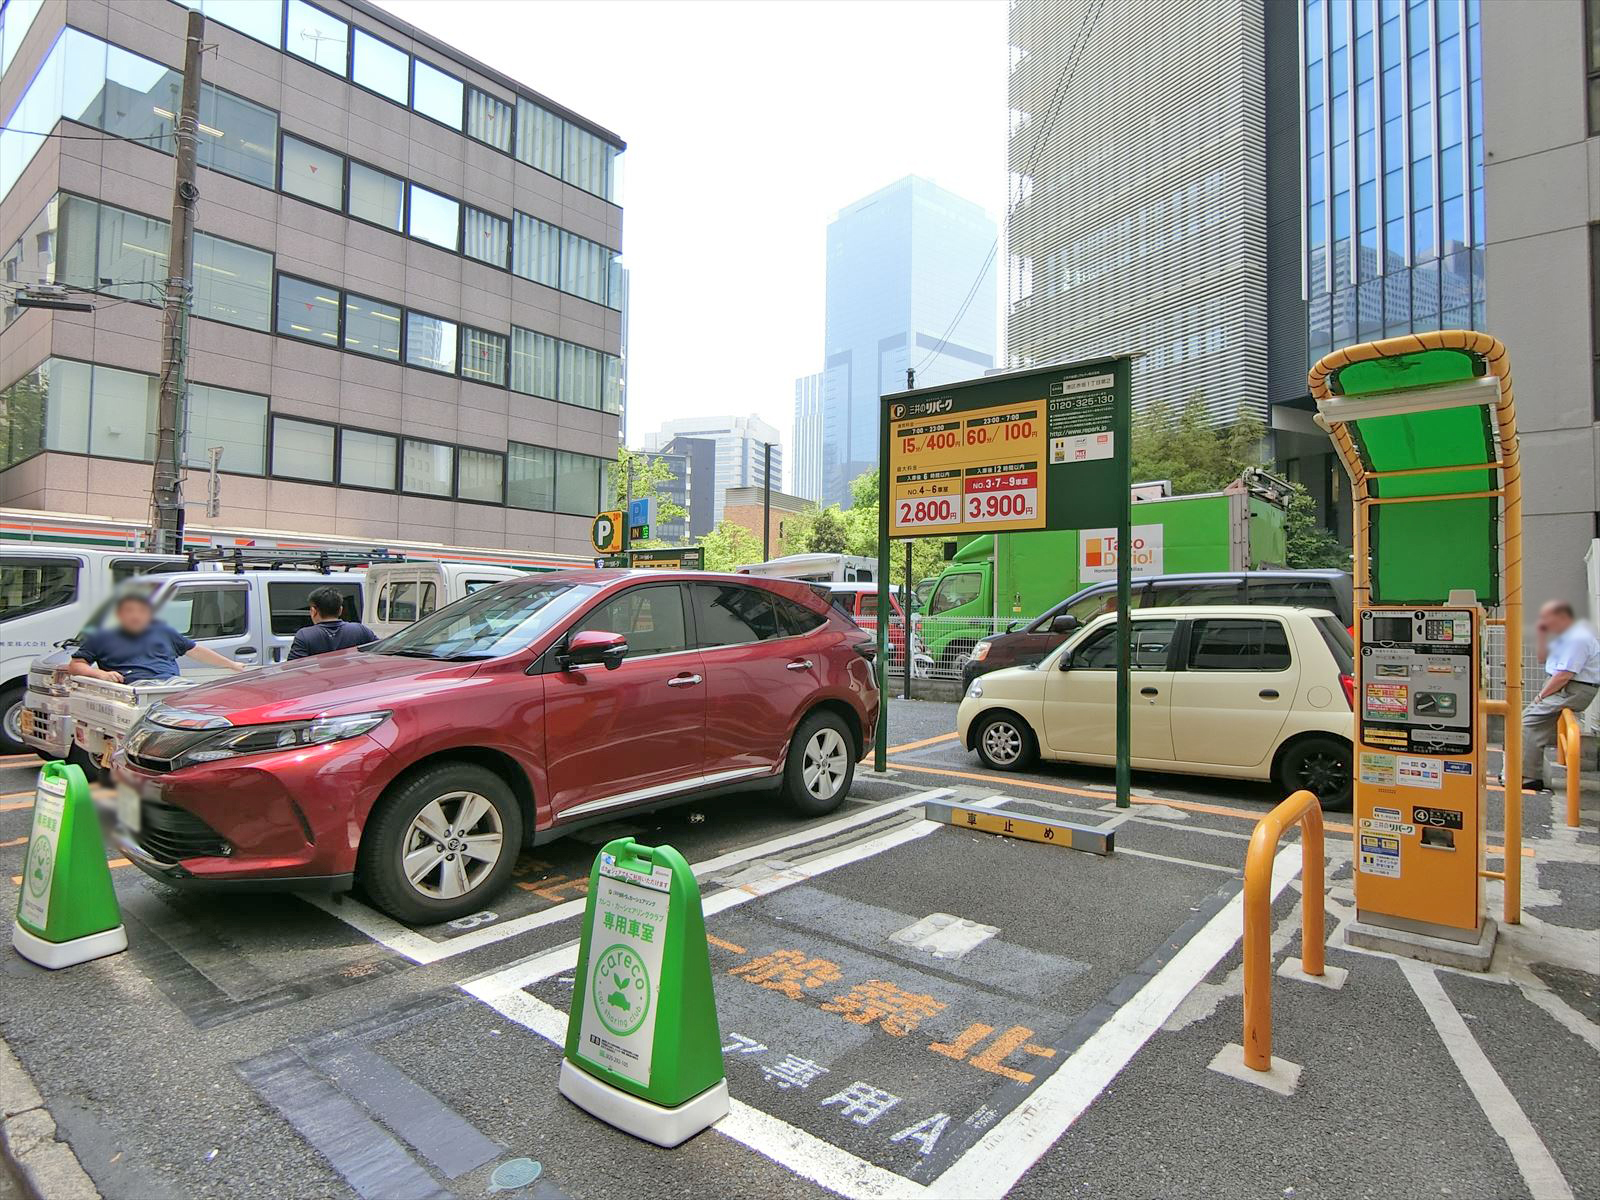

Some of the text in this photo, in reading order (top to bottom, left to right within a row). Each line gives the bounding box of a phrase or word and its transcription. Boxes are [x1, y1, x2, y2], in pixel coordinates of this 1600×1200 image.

[909, 399, 953, 415] 三井のリパーク
[983, 417, 999, 425] 23:00
[901, 500, 957, 523] 2,800円
[969, 493, 1033, 518] 3,900円
[598, 520, 611, 545] P
[1104, 537, 1144, 551] Tao
[1104, 550, 1153, 566] Dio!
[967, 813, 1054, 840] 車止め
[603, 911, 655, 943] 専用車室
[600, 952, 645, 990] careco
